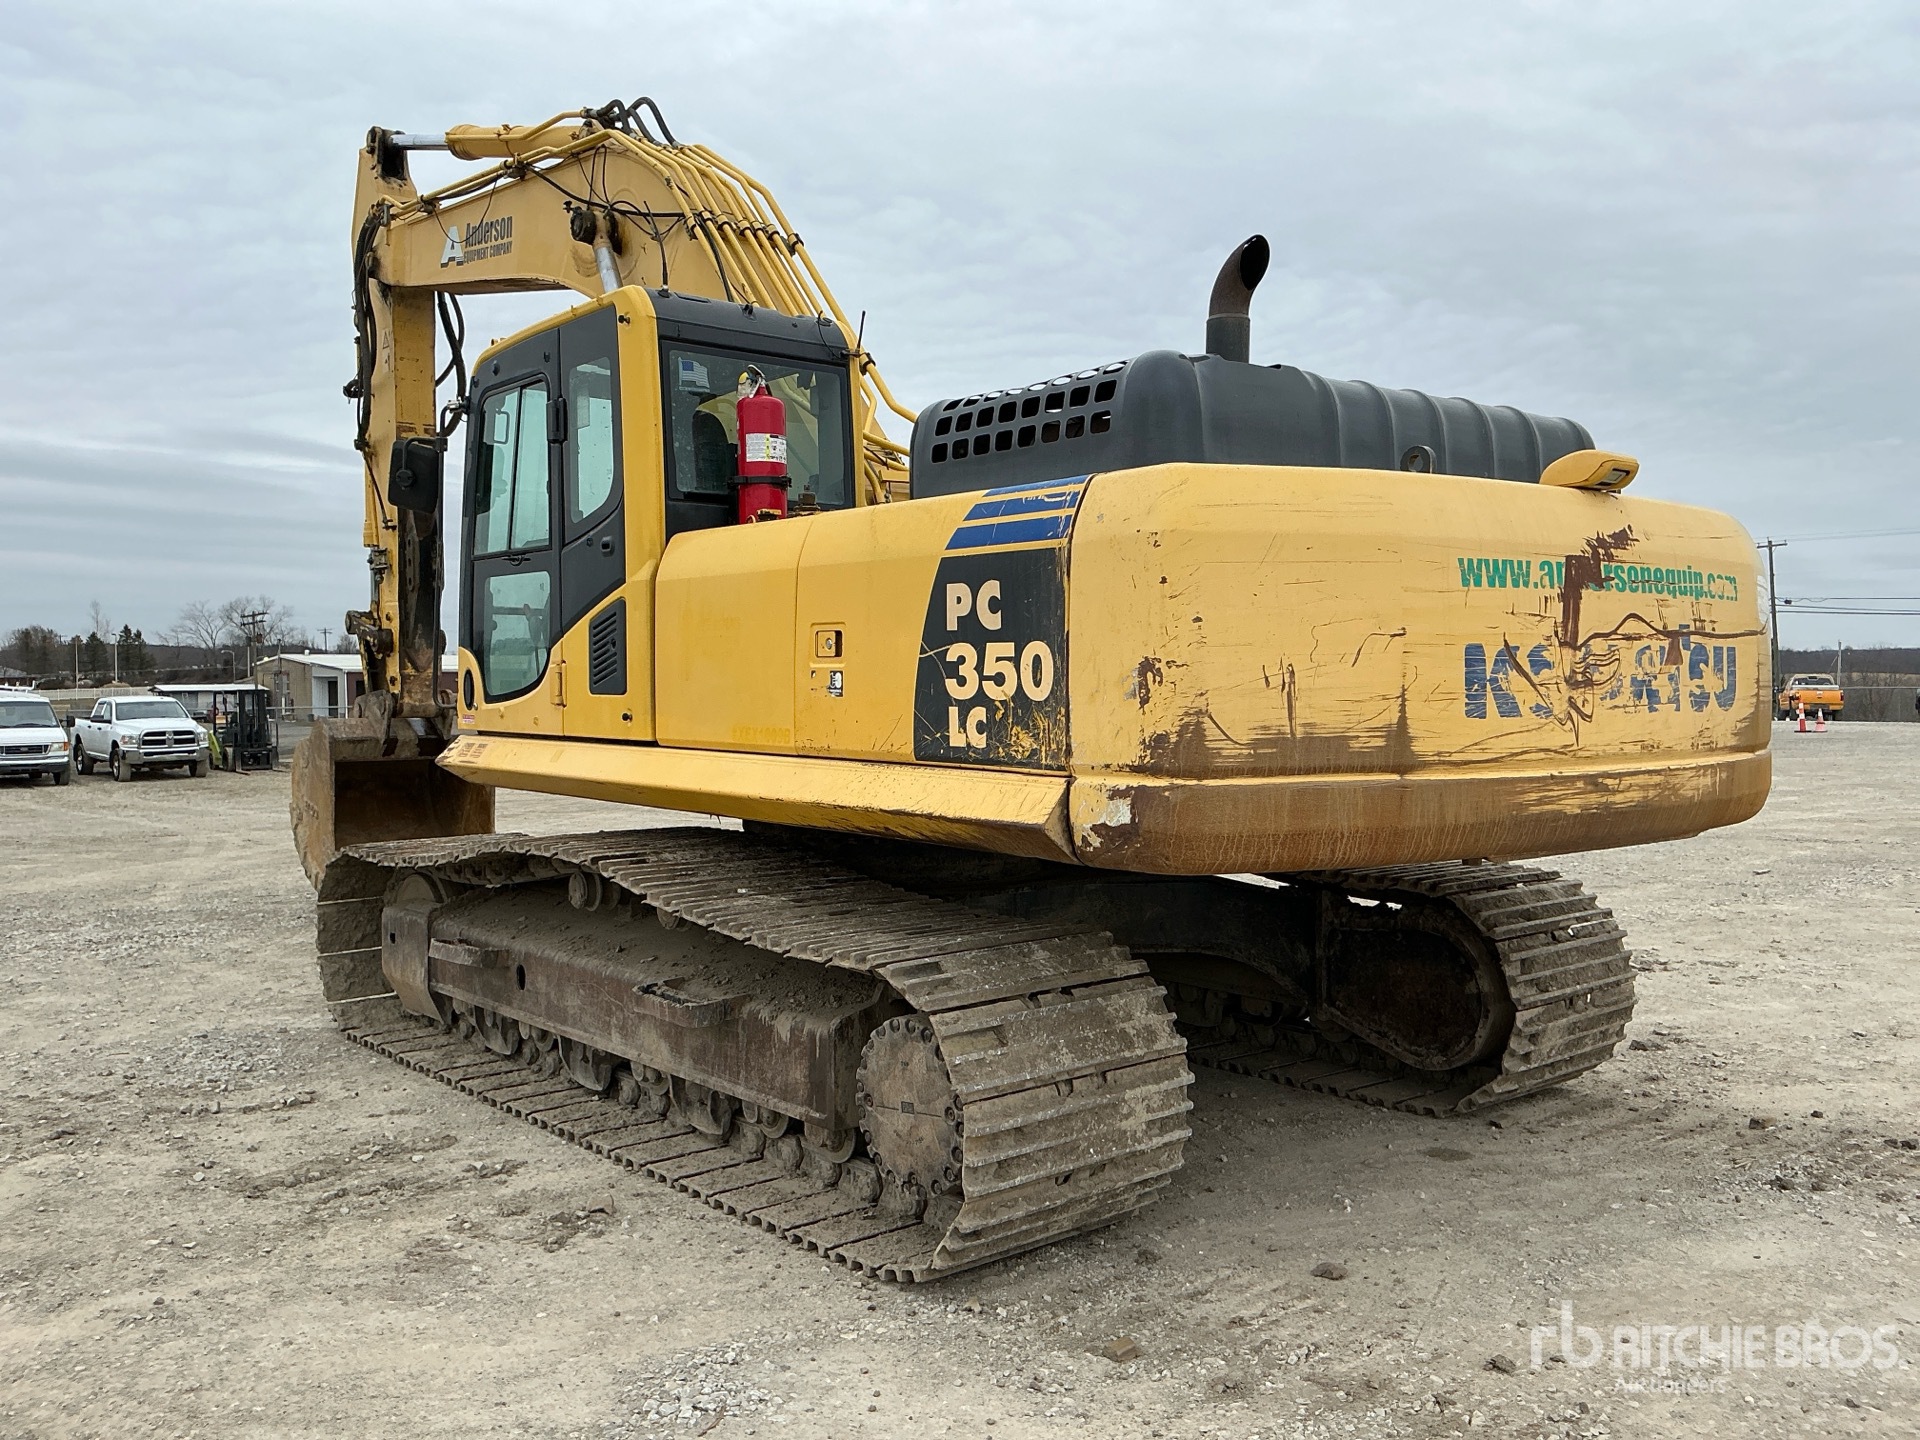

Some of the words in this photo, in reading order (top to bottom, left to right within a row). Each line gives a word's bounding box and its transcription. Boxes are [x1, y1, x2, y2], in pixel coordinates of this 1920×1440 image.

[463, 247, 489, 265] EQUIPMENT
[490, 241, 513, 258] COMPANY
[465, 216, 513, 249] Anderson
[1457, 555, 1738, 602] www.anrsonequip.com
[946, 580, 1002, 631] PC
[945, 641, 1054, 701] 350
[1463, 642, 1737, 719] KASU
[948, 706, 987, 748] LC
